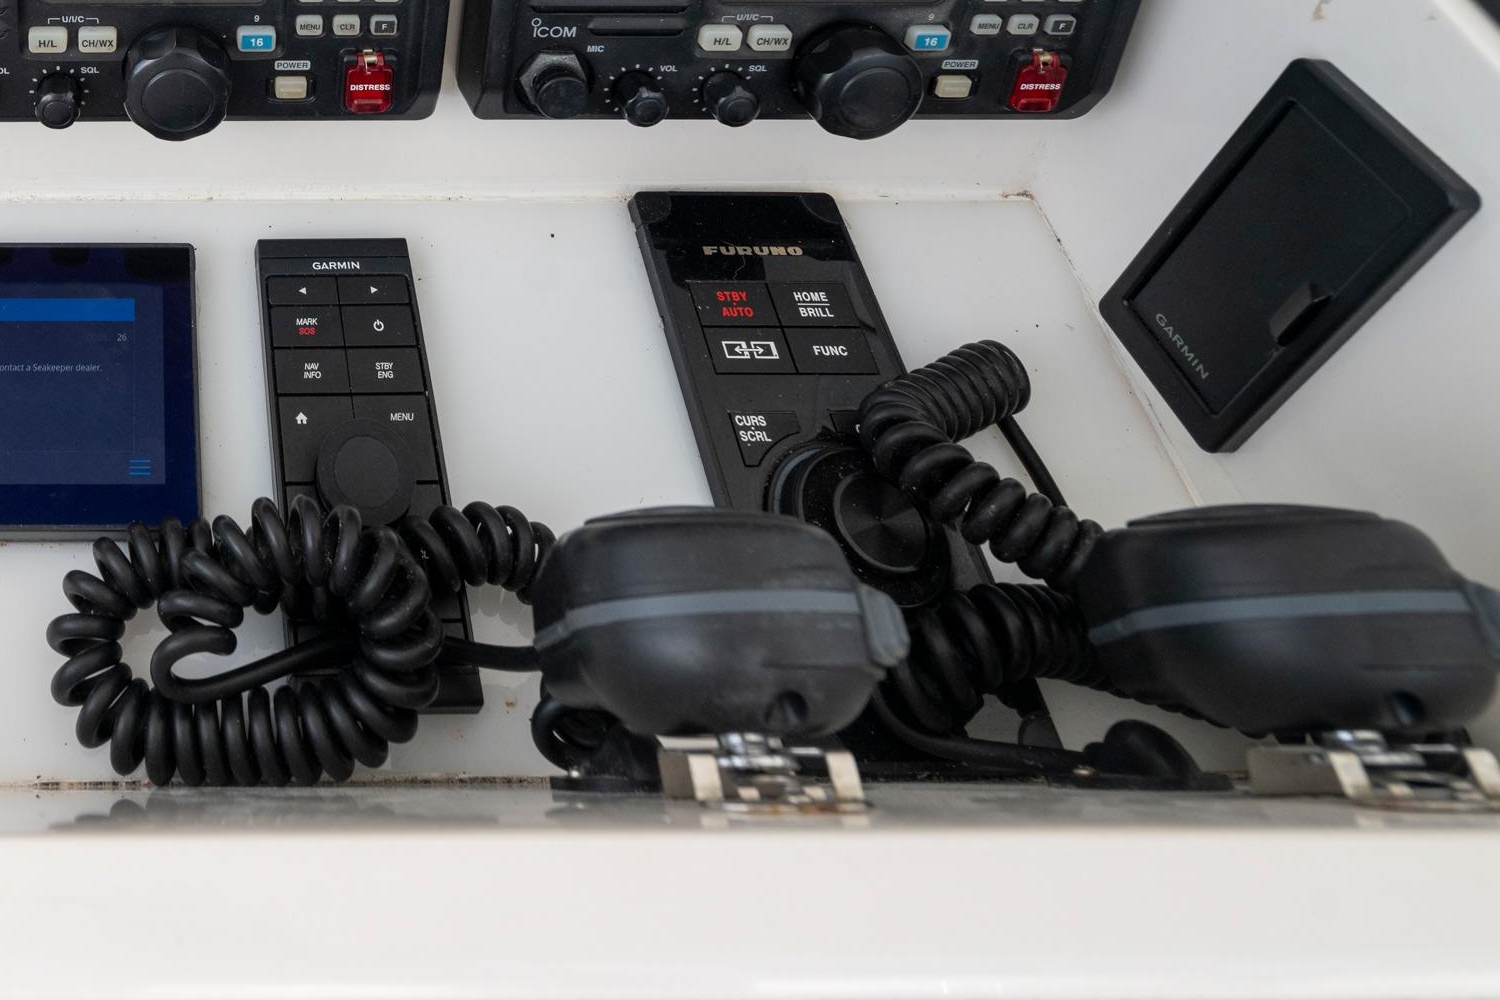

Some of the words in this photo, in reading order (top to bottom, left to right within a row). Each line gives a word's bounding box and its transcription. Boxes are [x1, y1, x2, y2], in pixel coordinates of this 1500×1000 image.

[254, 15, 260, 23] 9
[928, 13, 935, 21] 9
[38, 40, 57, 48] H/L
[82, 40, 114, 48] CH/WX
[250, 38, 264, 47] 16
[713, 37, 732, 45] H/L
[756, 37, 788, 45] CH/WX
[924, 38, 938, 46] 16
[587, 45, 605, 53] MIC
[80, 66, 100, 74] SQL
[702, 246, 803, 256] FURUNO
[312, 261, 360, 270] GARMIN
[716, 291, 748, 301] STBY
[793, 292, 828, 302] HOME
[722, 307, 754, 317] AUTO
[799, 307, 834, 318] BRILL
[296, 318, 318, 326] MARK
[298, 327, 316, 335] SOS
[116, 333, 127, 342] 26
[813, 345, 848, 356] FUNC
[1155, 313, 1209, 380] GARMIN
[32, 363, 73, 373] Seakeeper
[375, 362, 394, 370] STBY
[303, 371, 322, 379] INFO
[377, 371, 394, 379] ENG
[390, 412, 414, 421] MENU
[735, 415, 767, 426] CURS
[739, 431, 772, 442] SCRL
